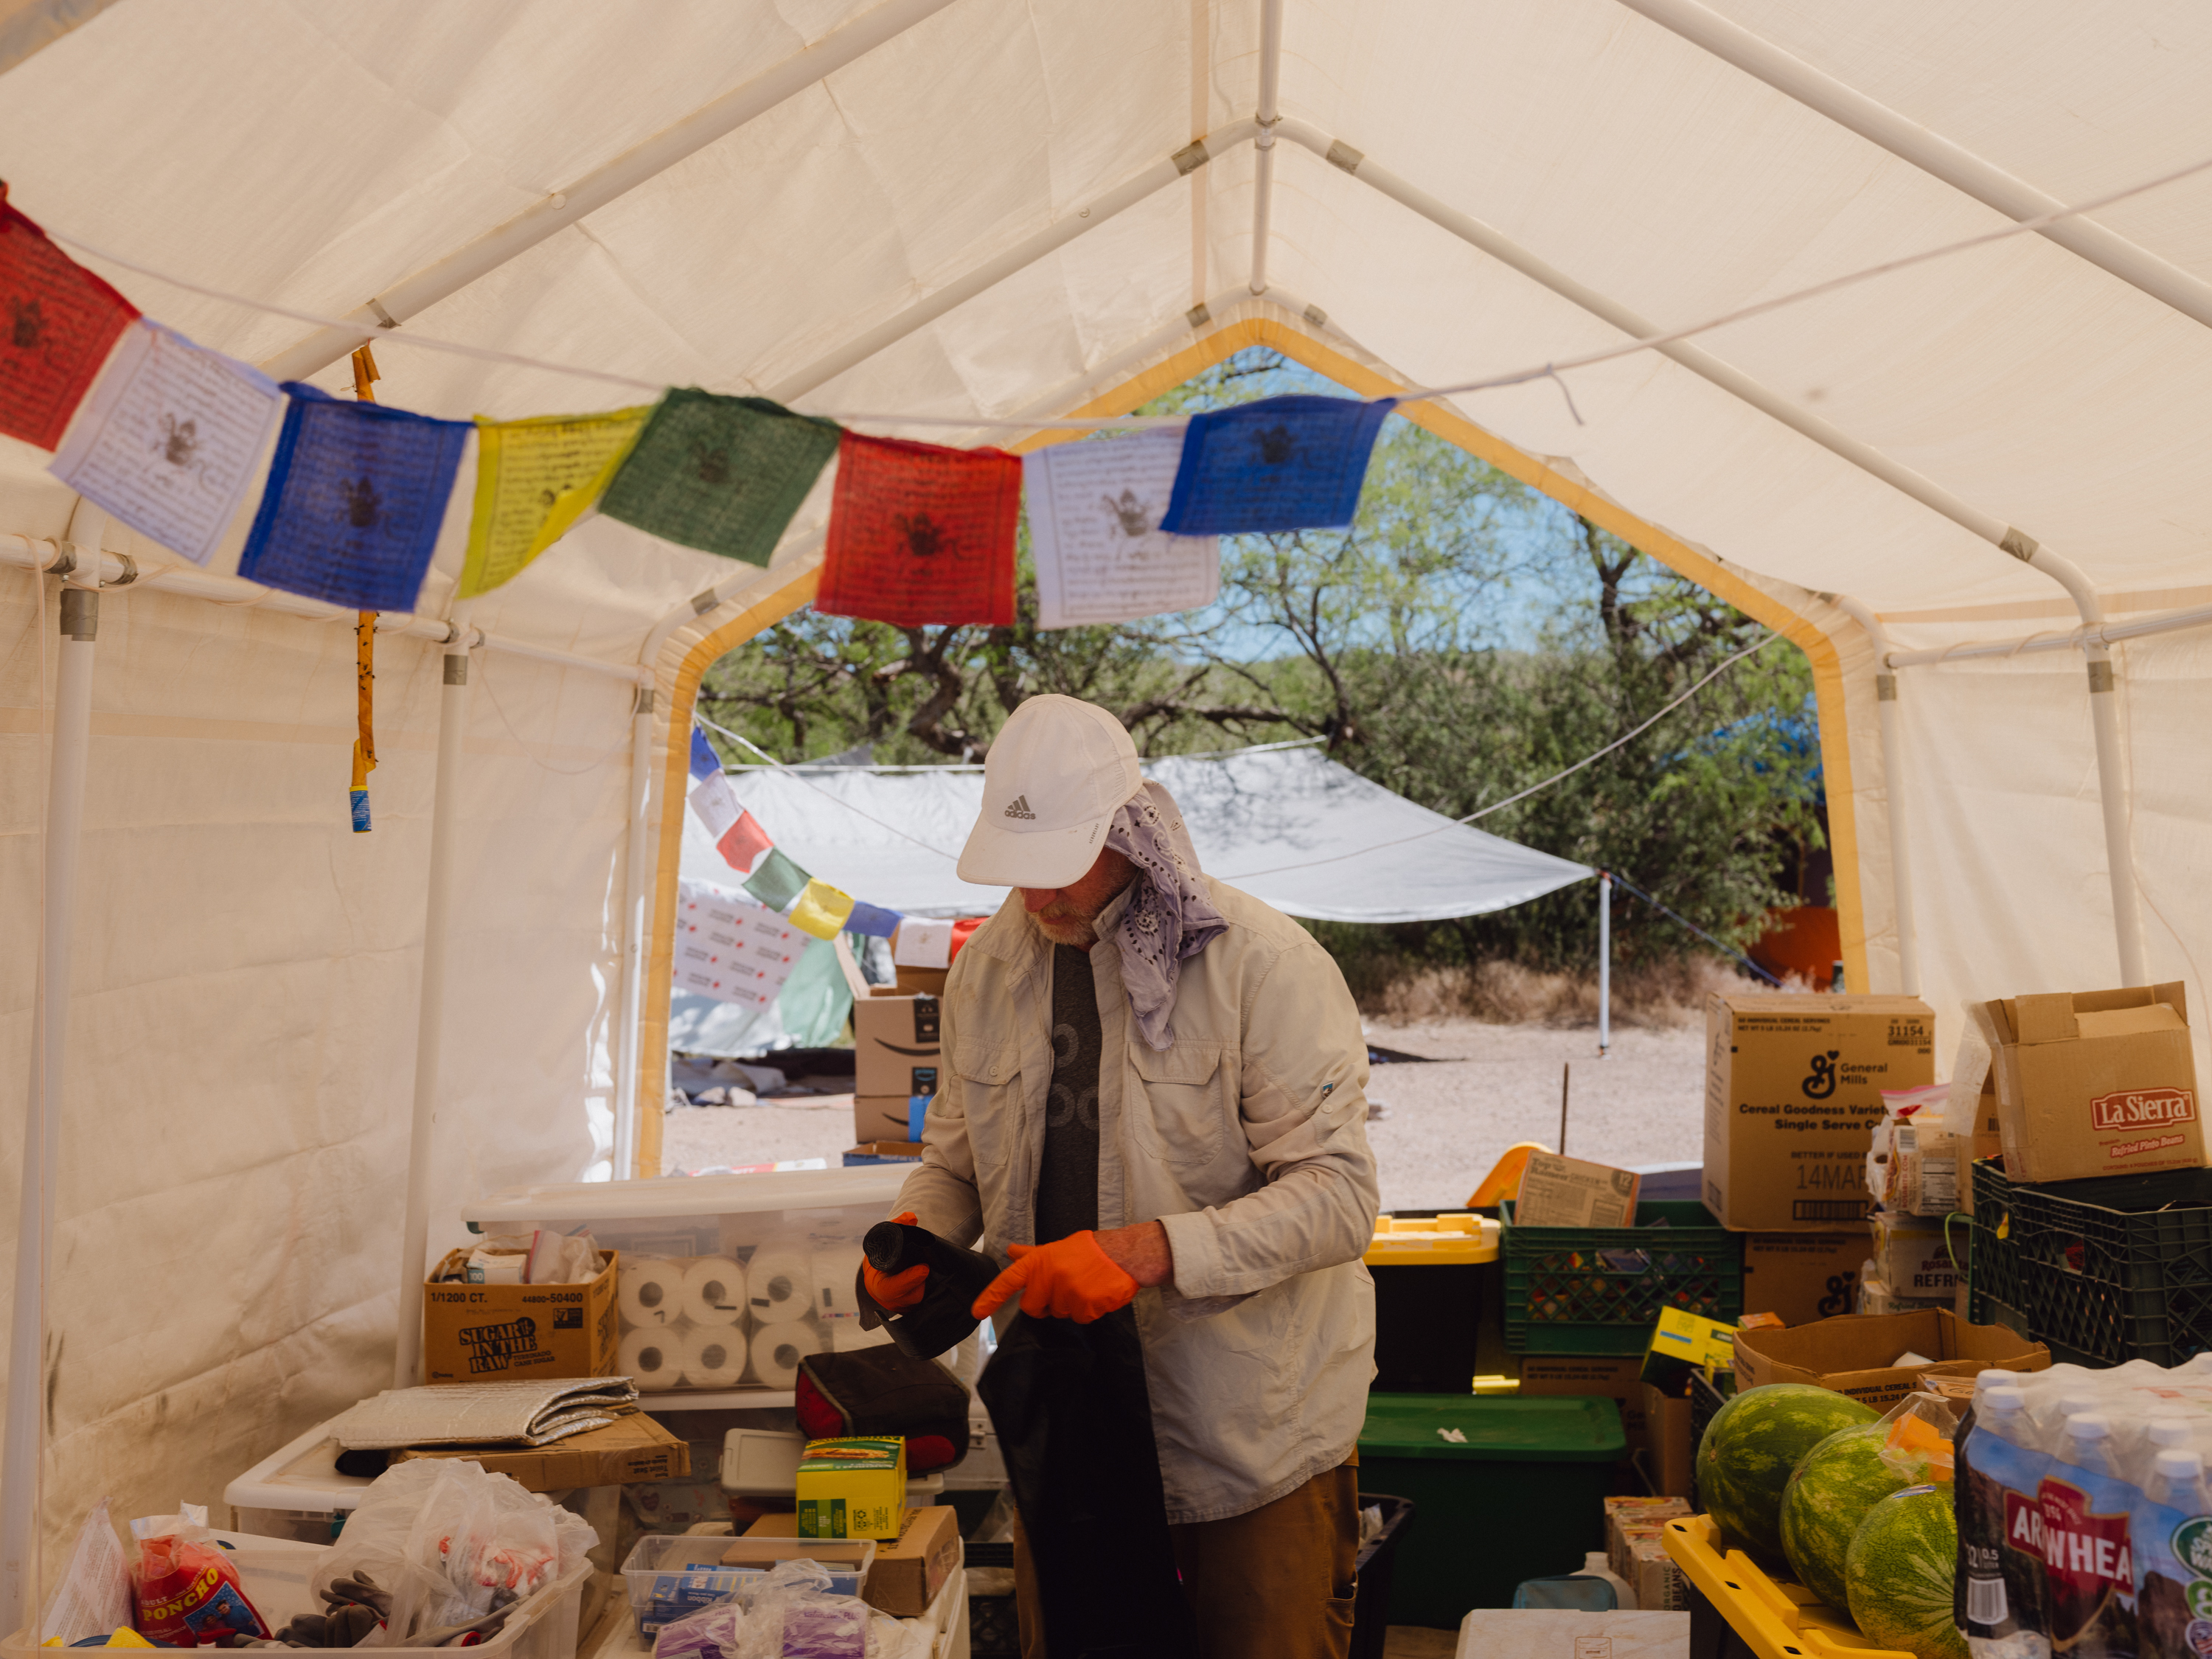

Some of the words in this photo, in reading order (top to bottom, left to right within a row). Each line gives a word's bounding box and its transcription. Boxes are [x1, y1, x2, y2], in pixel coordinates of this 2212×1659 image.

[1004, 809, 1036, 820] adidas
[1888, 1026, 1923, 1036] 31154
[1840, 1062, 1888, 1074] General
[1840, 1074, 1868, 1085] Mills
[1739, 1104, 1780, 1114] Cereal
[1784, 1105, 1844, 1115] Goodness
[2100, 1102, 2125, 1124] La
[2126, 1096, 2188, 1121] Sierra
[1775, 1119, 1817, 1131] Single
[1822, 1120, 1860, 1130] Serve
[2111, 1142, 2139, 1157] Refried
[2140, 1138, 2160, 1150] Pinto
[2160, 1135, 2184, 1147] Beans
[1791, 1151, 1823, 1159] BETTER
[1531, 1157, 1551, 1170] Top
[1921, 1259, 1969, 1271] Rosarta
[470, 1272, 483, 1281] 100
[431, 1293, 466, 1303] 1/1200
[470, 1293, 487, 1304] CT.
[522, 1293, 582, 1304] 44800-50400
[460, 1324, 521, 1343] SUGAR
[473, 1342, 493, 1357] IN
[495, 1336, 535, 1355] THE
[514, 1350, 552, 1360] TURBINADO
[470, 1355, 509, 1373] RAW
[514, 1359, 532, 1367] CANE
[533, 1356, 555, 1364] SUGAR
[1844, 1385, 1883, 1395] INDIVIDUAL
[1885, 1382, 1911, 1391] CEREAL
[1880, 1394, 1900, 1402] 15.24
[1982, 1549, 1999, 1561] 0.5
[1672, 1567, 1683, 1602] BEANS
[142, 1568, 219, 1621] PONCHO
[687, 1596, 713, 1604] Ribbon
[142, 1596, 168, 1606] ADULT
[844, 1612, 860, 1620] PLUS
